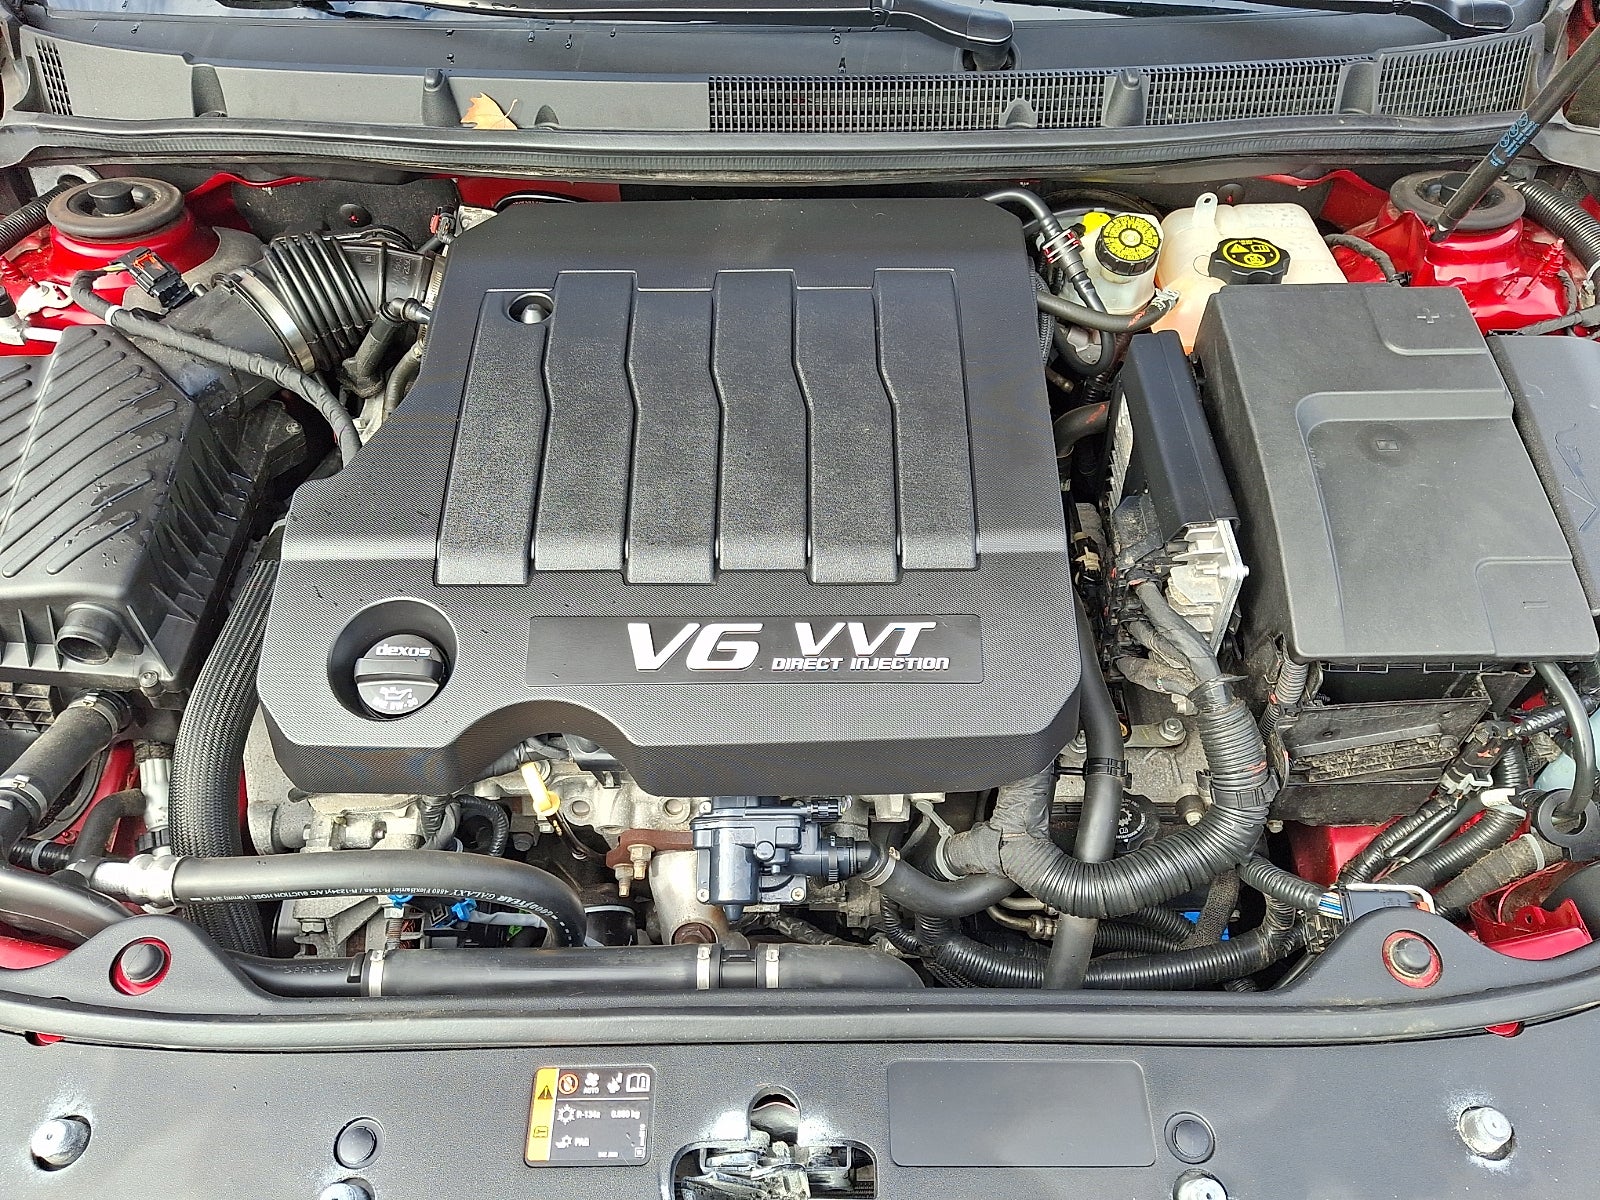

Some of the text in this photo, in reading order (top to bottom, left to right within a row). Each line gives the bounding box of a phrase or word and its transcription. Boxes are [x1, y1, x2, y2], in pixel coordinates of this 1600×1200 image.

[376, 644, 432, 656] dexos
[627, 622, 937, 671] V6 VVT
[772, 657, 949, 671] DIRECT INJECTION
[274, 890, 309, 898] SUCTION
[449, 889, 496, 900] GALAXY
[497, 895, 554, 917] GOODYEAR
